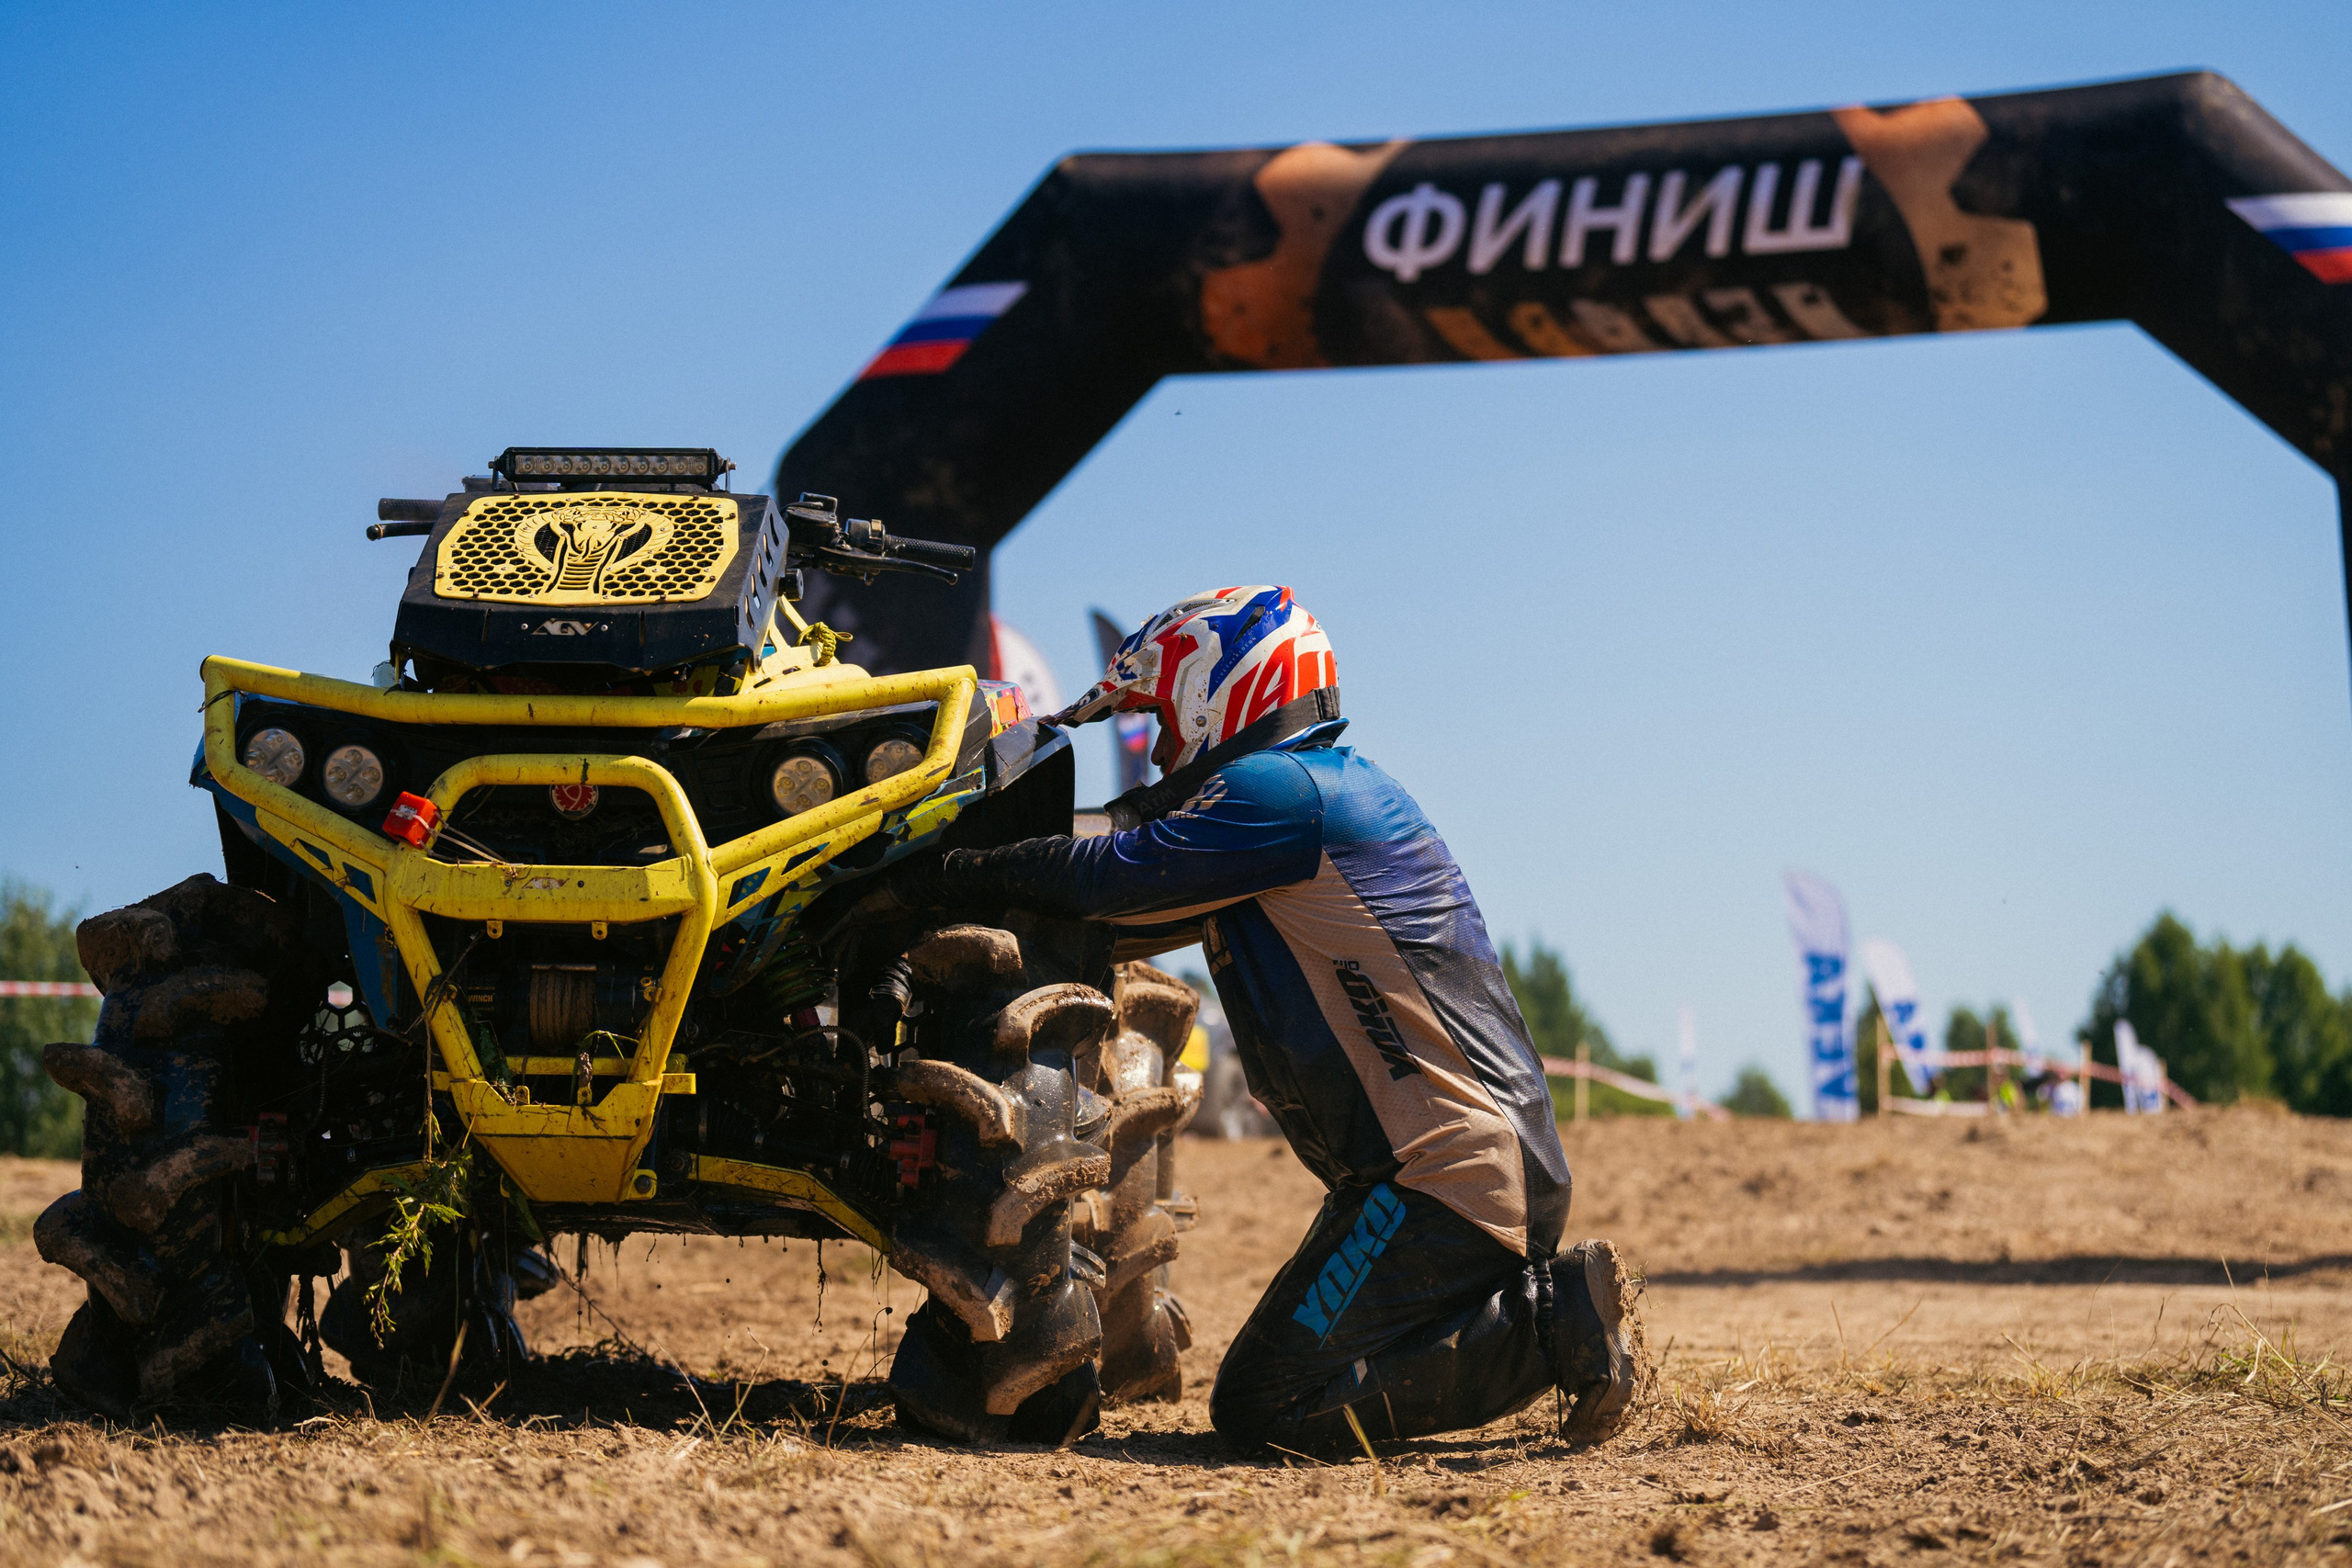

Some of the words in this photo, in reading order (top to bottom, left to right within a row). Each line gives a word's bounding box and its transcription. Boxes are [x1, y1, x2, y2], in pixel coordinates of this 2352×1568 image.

[1363, 155, 1864, 282] ФИНИШ
[1335, 968, 1428, 1081] YOKO
[1292, 1182, 1407, 1344] YOKO
